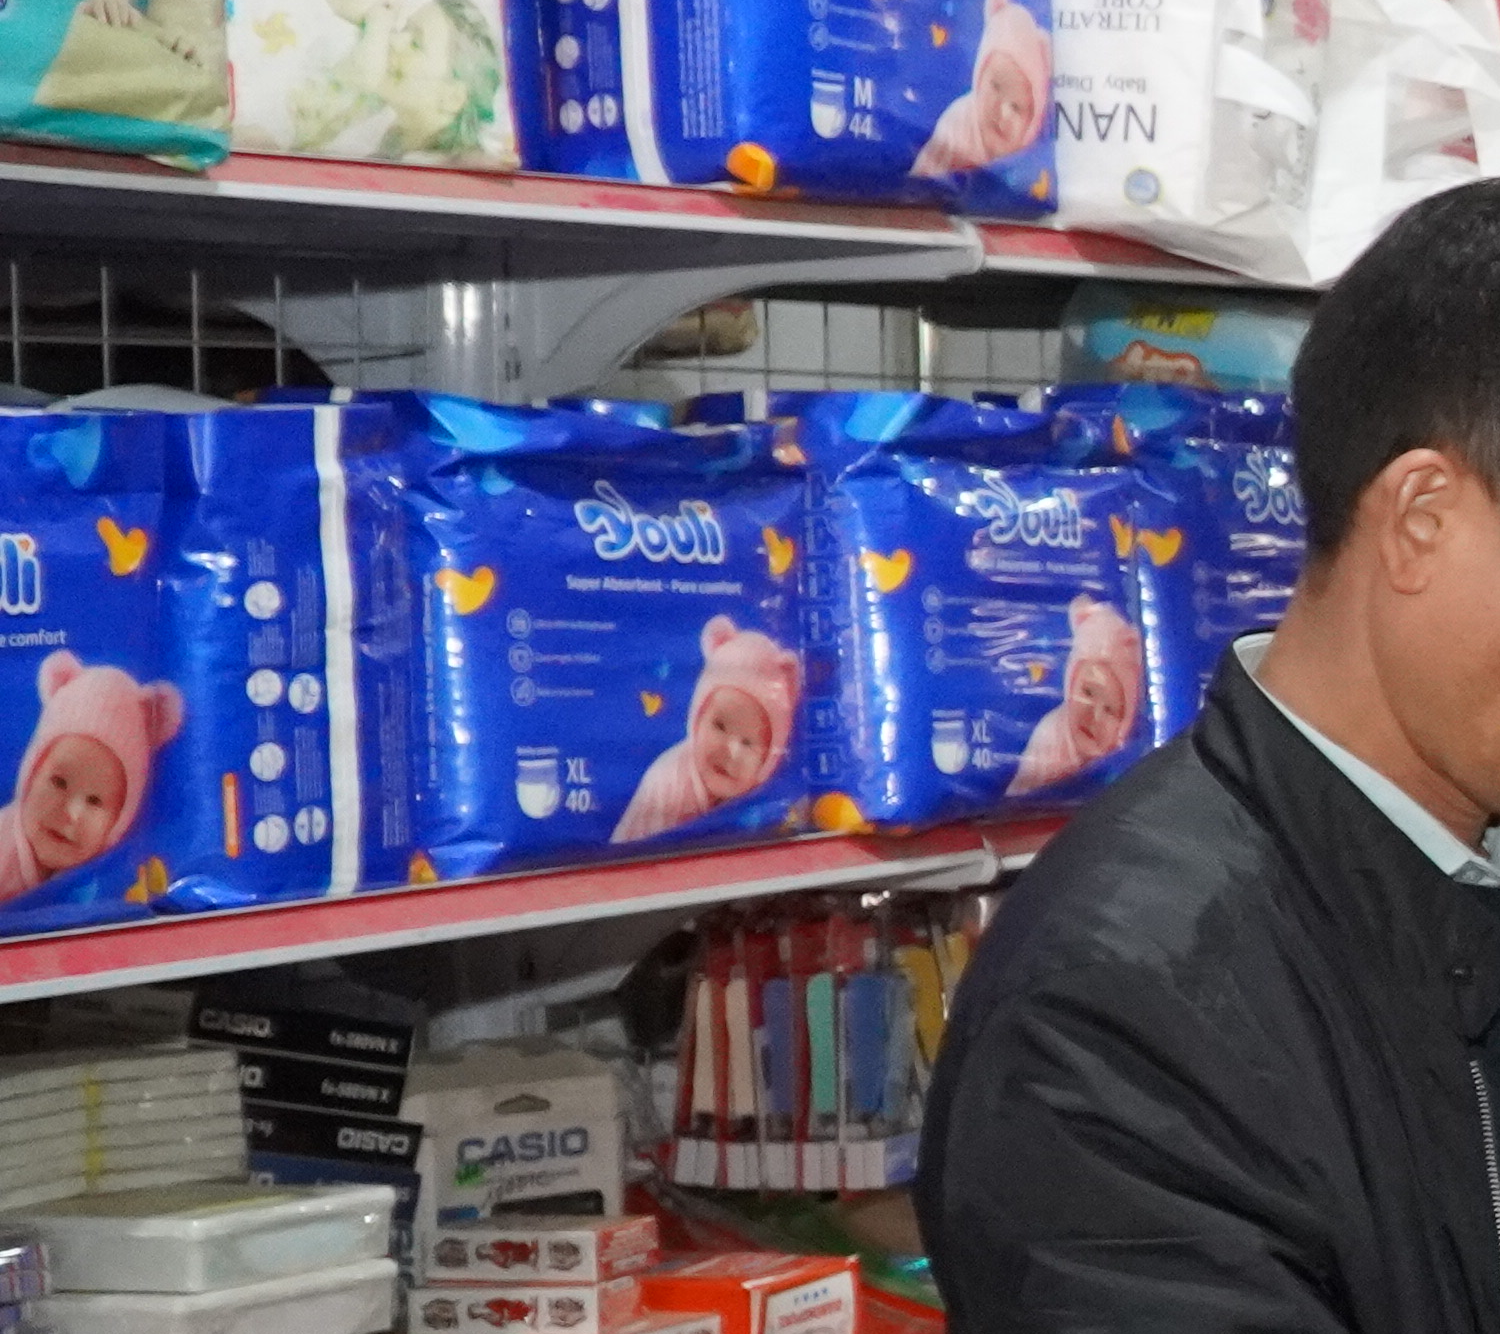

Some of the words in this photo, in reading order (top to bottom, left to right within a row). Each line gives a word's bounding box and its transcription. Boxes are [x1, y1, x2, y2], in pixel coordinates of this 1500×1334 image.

[854, 77, 874, 110] M
[1103, 75, 1147, 94] Baby
[848, 114, 872, 140] 44
[574, 480, 725, 564] Douli
[567, 575, 600, 593] Super
[603, 577, 662, 594] Absorbent
[9, 628, 68, 647] comfort
[971, 718, 994, 745] XL
[566, 758, 592, 785] XL
[971, 746, 993, 771] 40
[565, 789, 592, 814] 40
[336, 1126, 410, 1157] CASIO
[456, 1126, 590, 1167] CASIO
